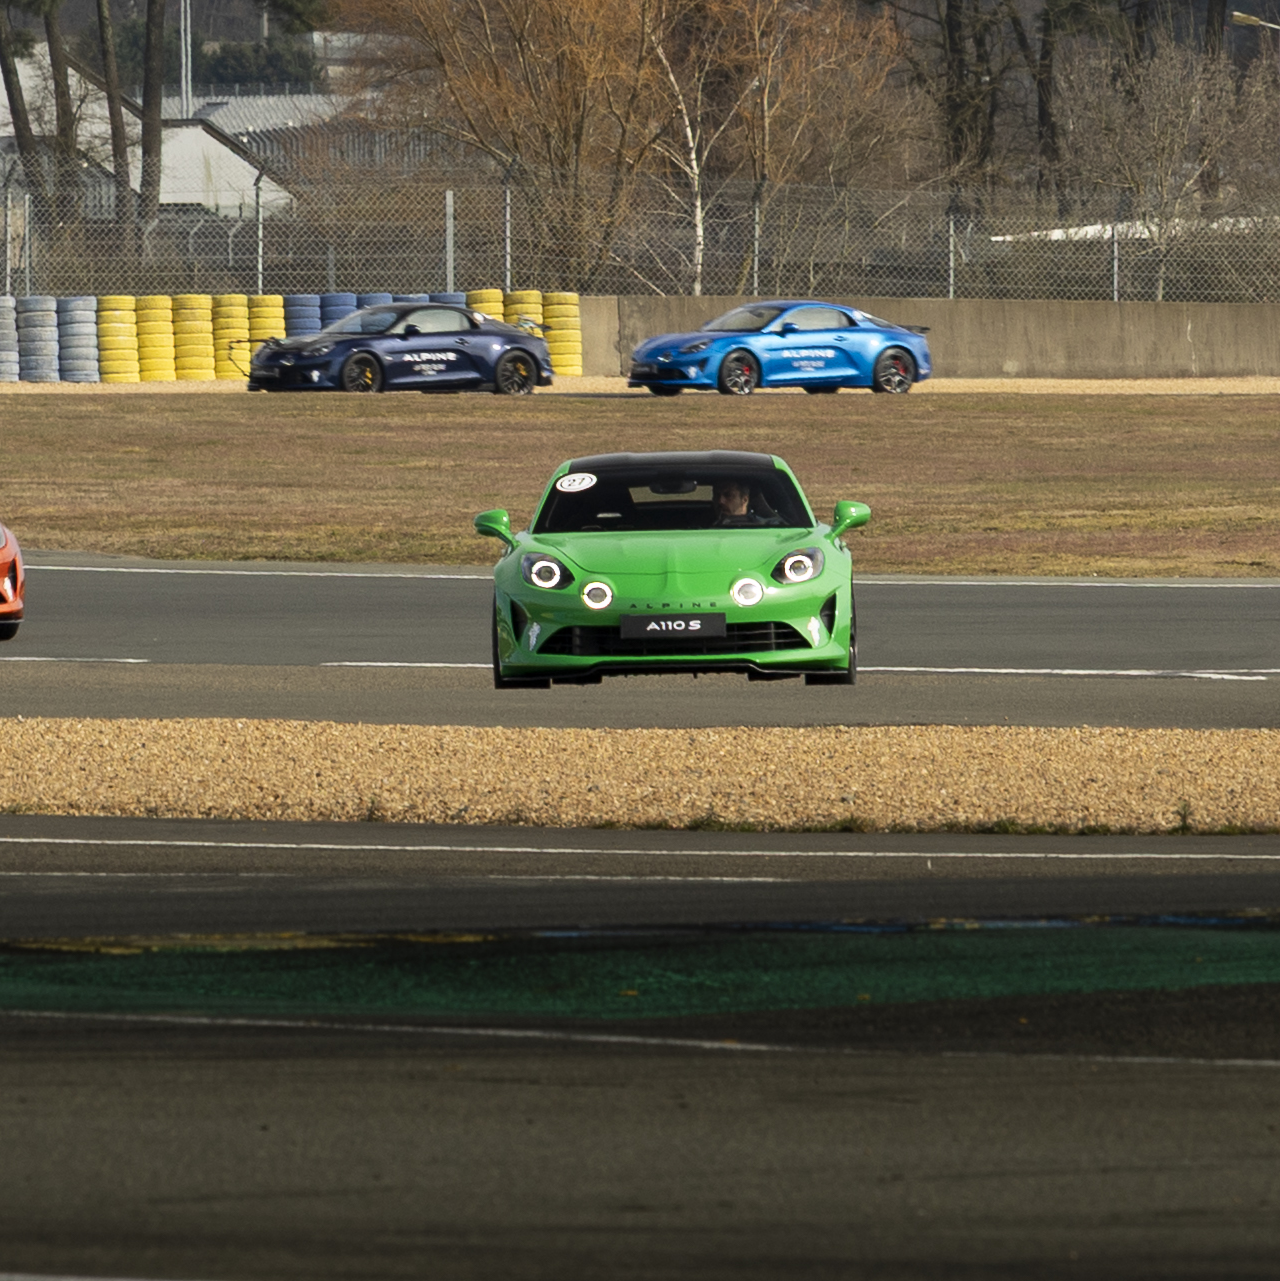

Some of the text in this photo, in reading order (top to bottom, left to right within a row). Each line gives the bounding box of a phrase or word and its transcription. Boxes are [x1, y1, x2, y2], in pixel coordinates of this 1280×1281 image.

[402, 352, 457, 361] ALPINE
[781, 349, 835, 358] ALPINE
[646, 620, 701, 631] A110 S
